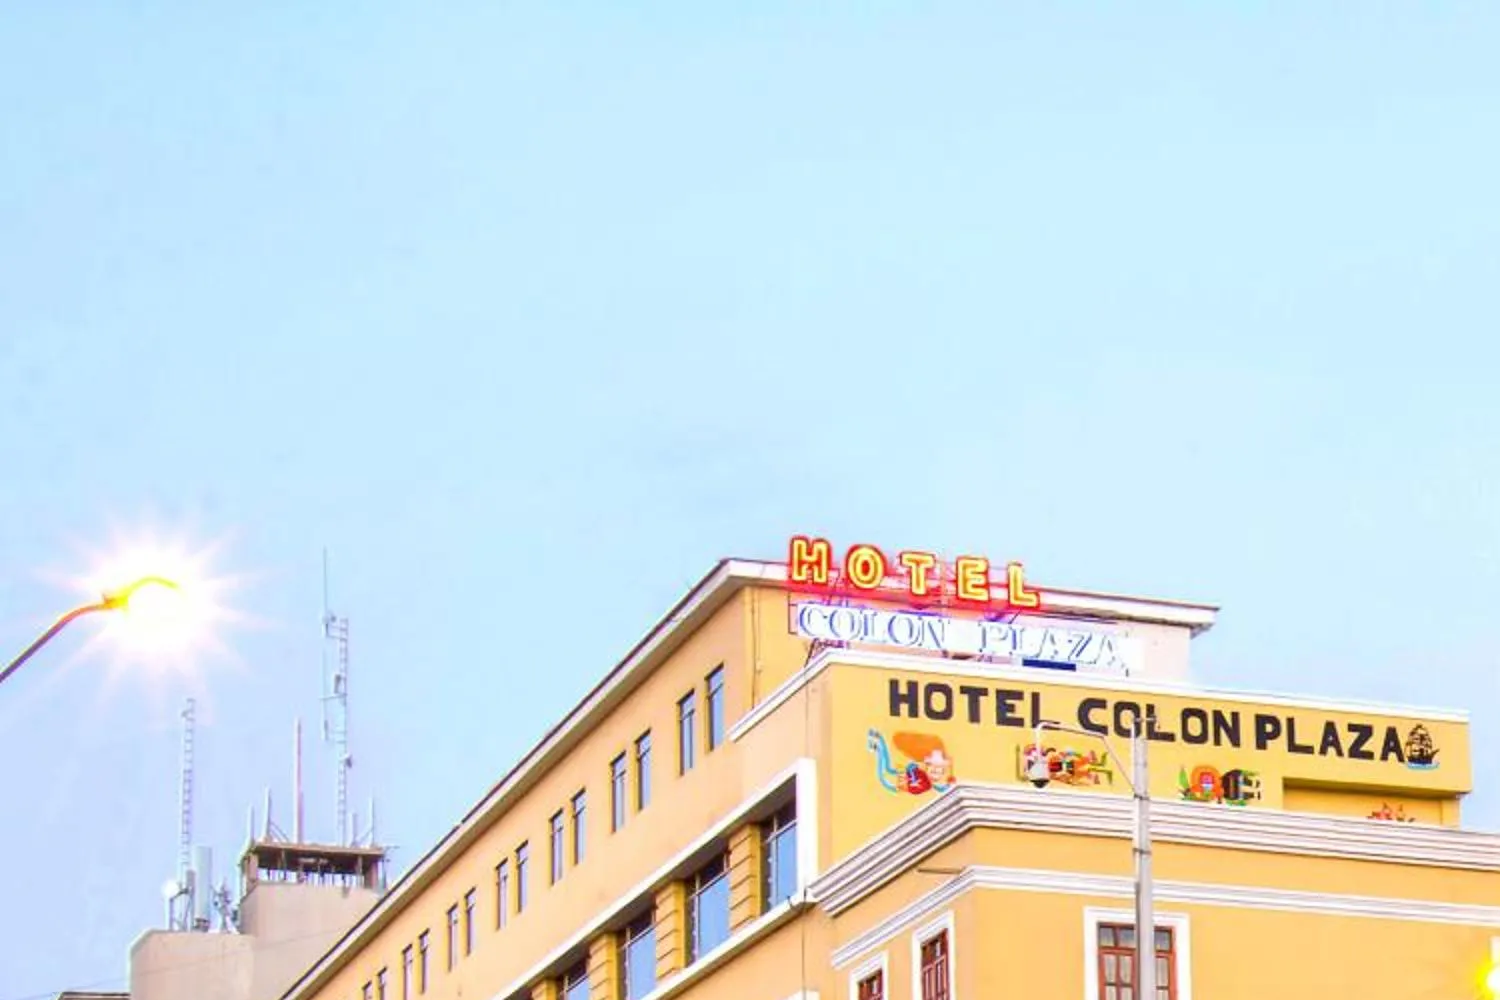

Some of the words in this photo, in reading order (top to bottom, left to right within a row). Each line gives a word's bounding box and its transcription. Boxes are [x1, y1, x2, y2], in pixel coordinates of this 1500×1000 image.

[790, 536, 1040, 608] HOTEL
[798, 603, 946, 652] COLON
[978, 620, 1121, 668] PLAZA
[889, 679, 1060, 731] HOTEL
[1077, 697, 1241, 748] COLON
[1254, 713, 1406, 763] PLAZA
